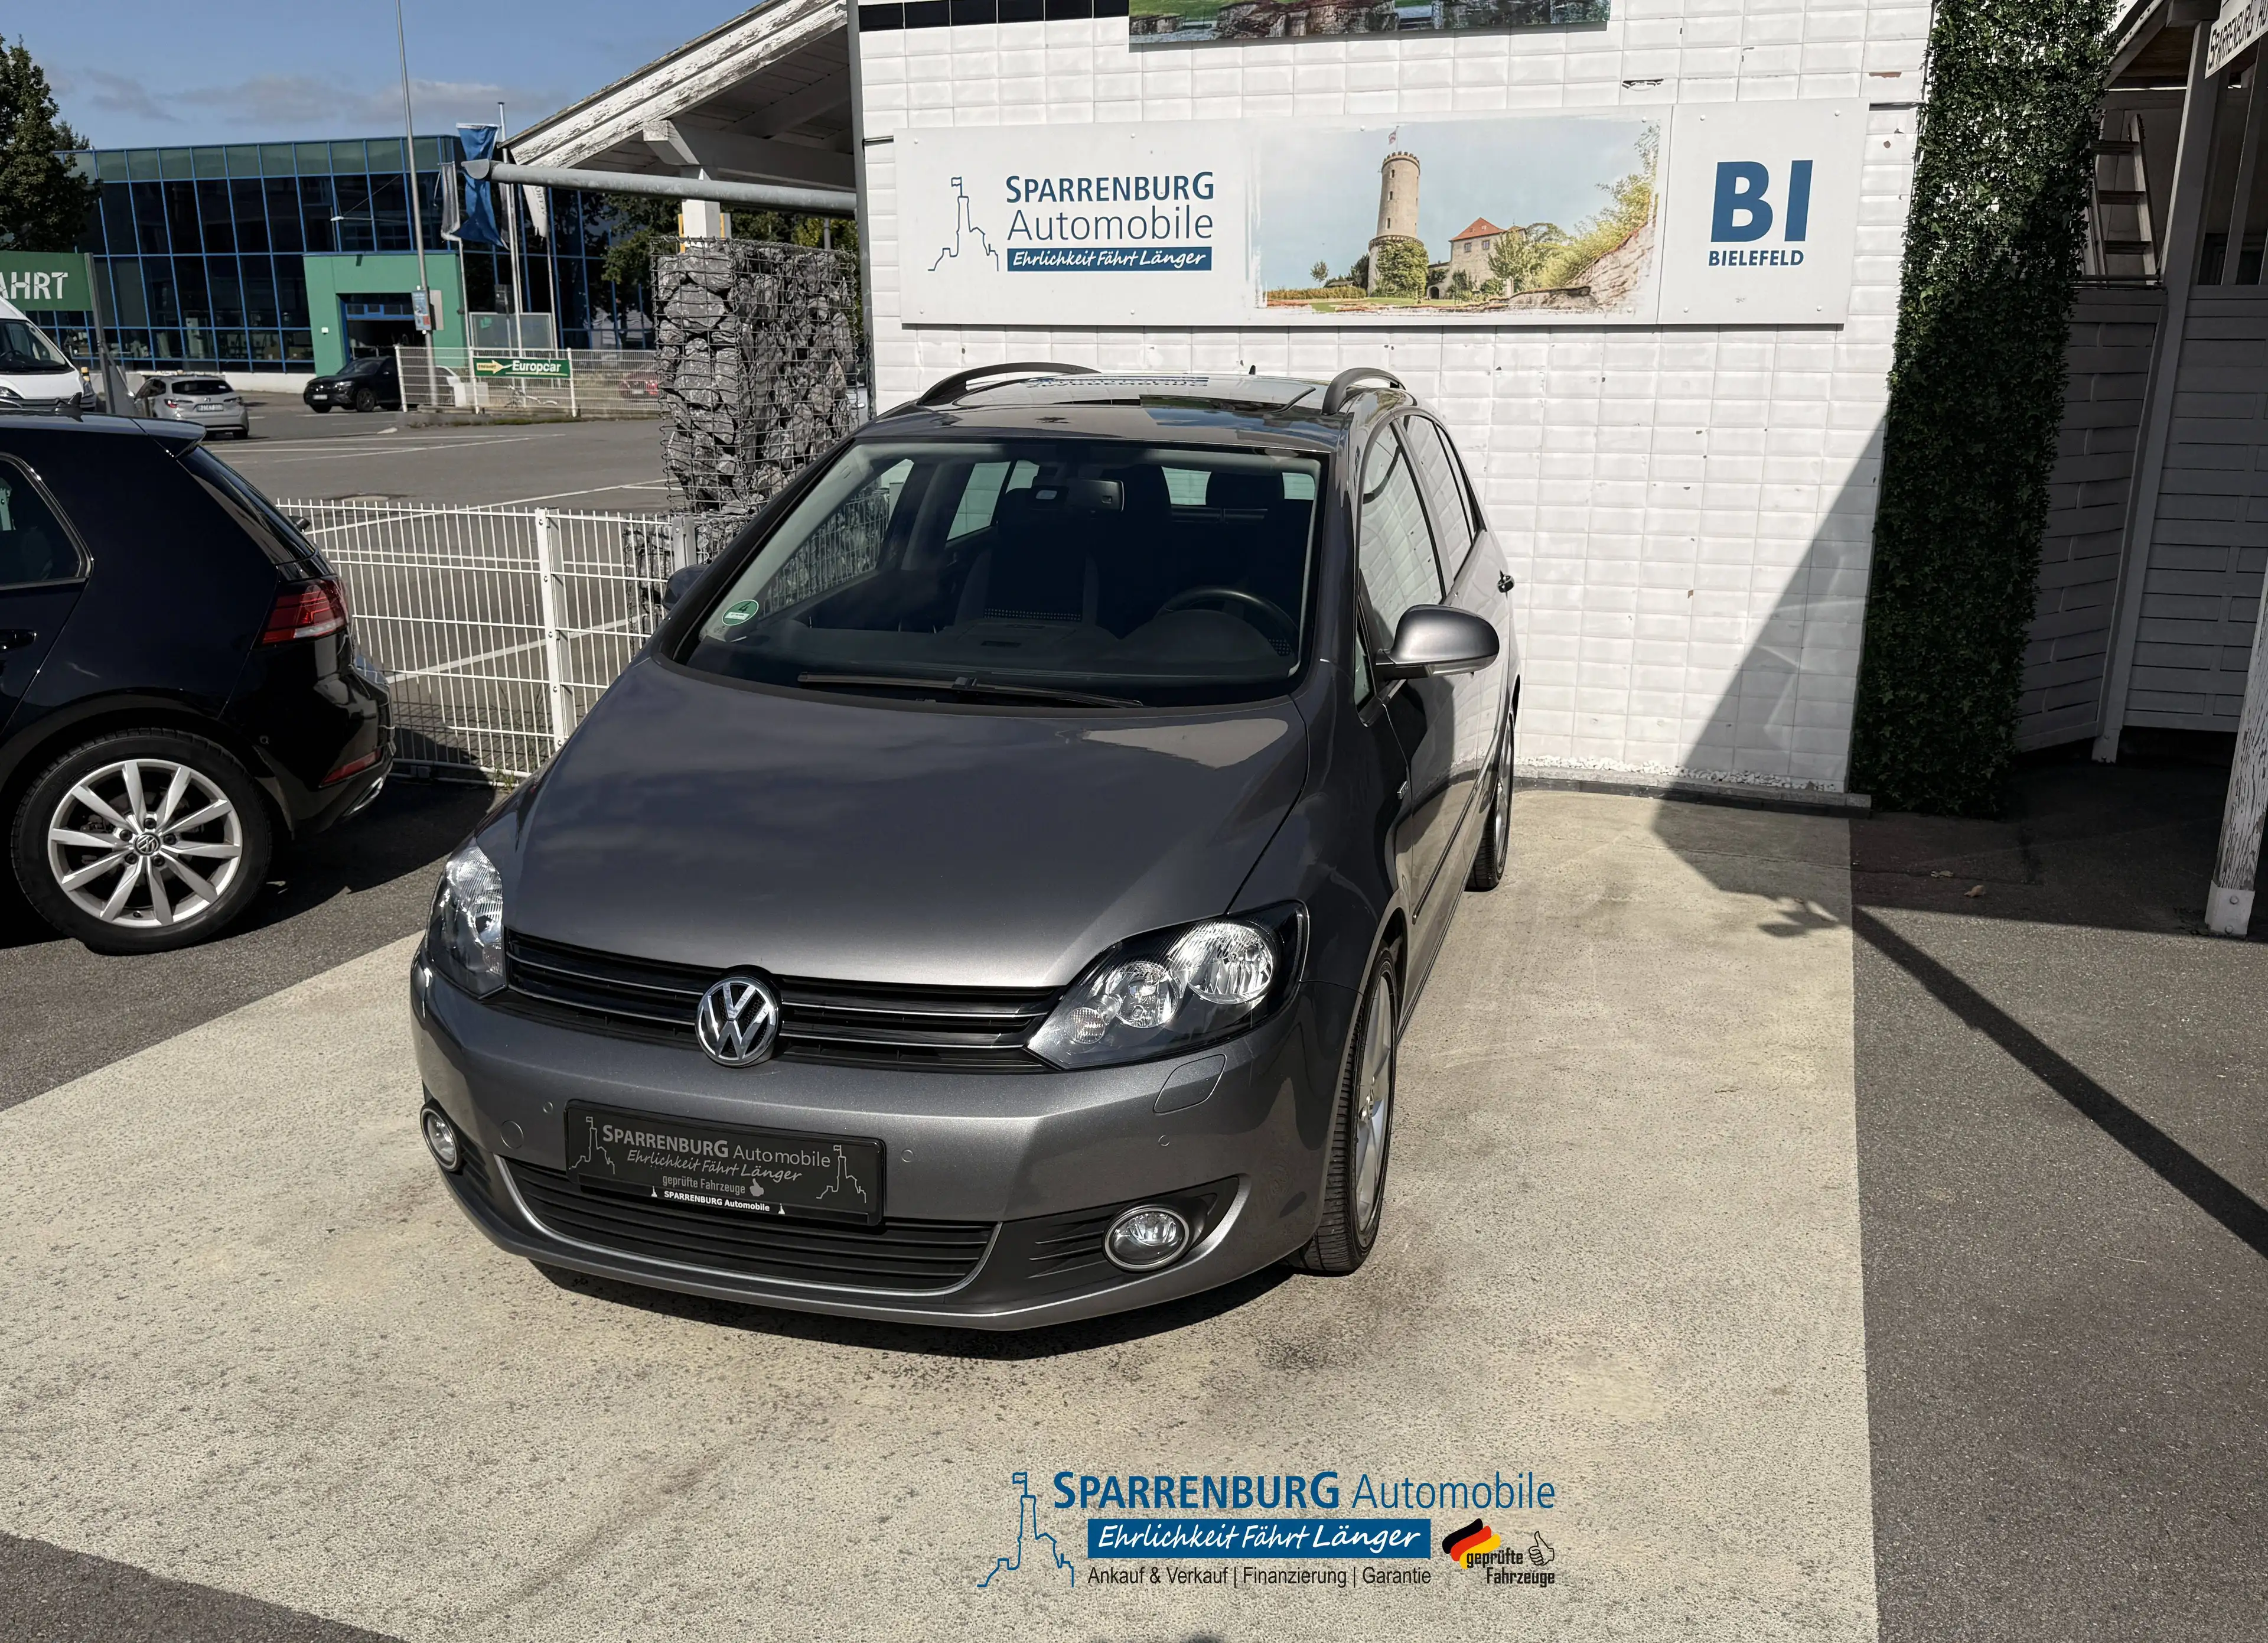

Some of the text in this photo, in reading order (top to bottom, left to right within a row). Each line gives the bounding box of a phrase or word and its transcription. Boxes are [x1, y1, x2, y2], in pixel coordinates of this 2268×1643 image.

[1006, 171, 1214, 203] SPARRENBURG
[1710, 160, 1813, 242] BI
[1007, 204, 1213, 241] Automobile
[1012, 249, 1206, 269] Ehrlichkeit Fährt Länger
[1708, 249, 1804, 266] BIELEFELD
[512, 360, 562, 375] Europcar
[602, 1124, 830, 1167] SPARRENBURG Automobile
[627, 1149, 802, 1183] Ehrlichkeit Fährt Länger
[662, 1175, 746, 1196] geprüfte Fahrzeuge
[664, 1190, 770, 1212] SPARRENBURG Automobile
